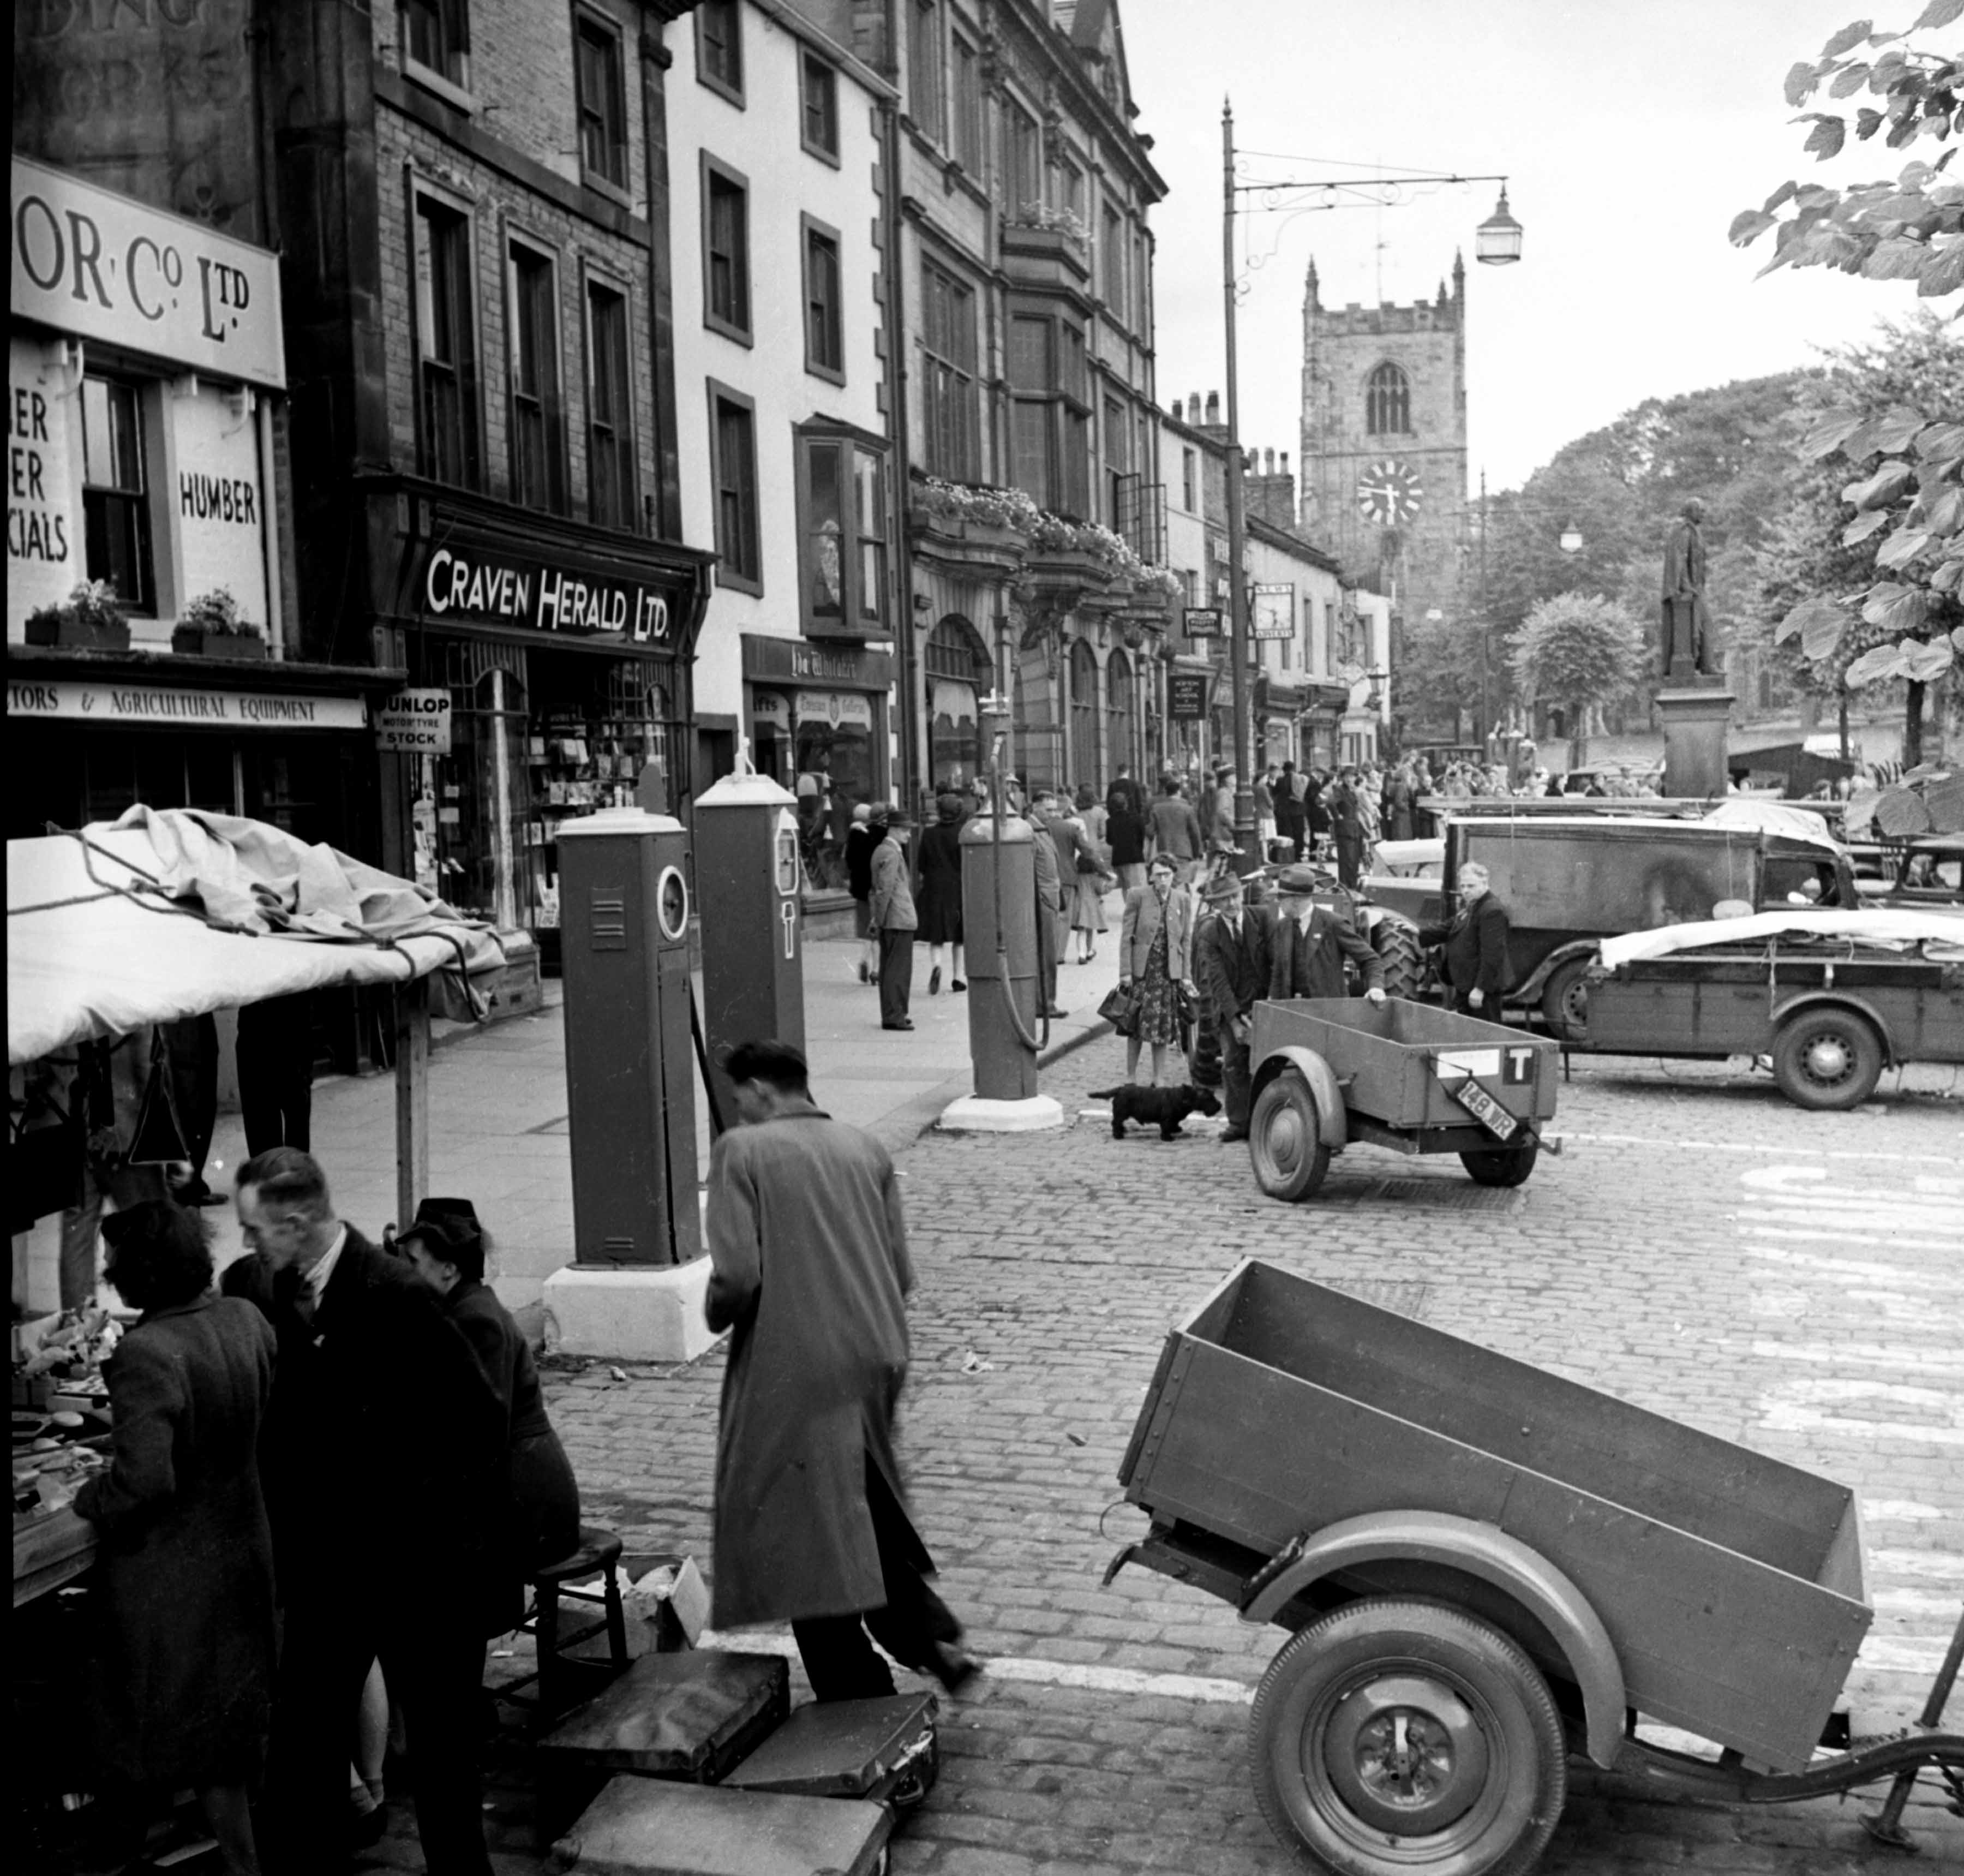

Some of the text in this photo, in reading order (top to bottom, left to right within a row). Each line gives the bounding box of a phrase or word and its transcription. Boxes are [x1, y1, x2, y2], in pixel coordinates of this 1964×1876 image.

[179, 471, 256, 525] HUMBER
[8, 507, 68, 563] CIALS
[427, 548, 531, 616] CRAVEN
[537, 568, 627, 631] HERALD
[8, 685, 58, 710] TORS
[110, 690, 228, 719] AGRICULTURAL
[239, 698, 317, 721] EQUIPMENT
[417, 718, 440, 728] TYRE
[387, 732, 436, 744] STOCK
[1510, 1048, 1533, 1080] T
[1460, 1083, 1513, 1138] 148 WR
